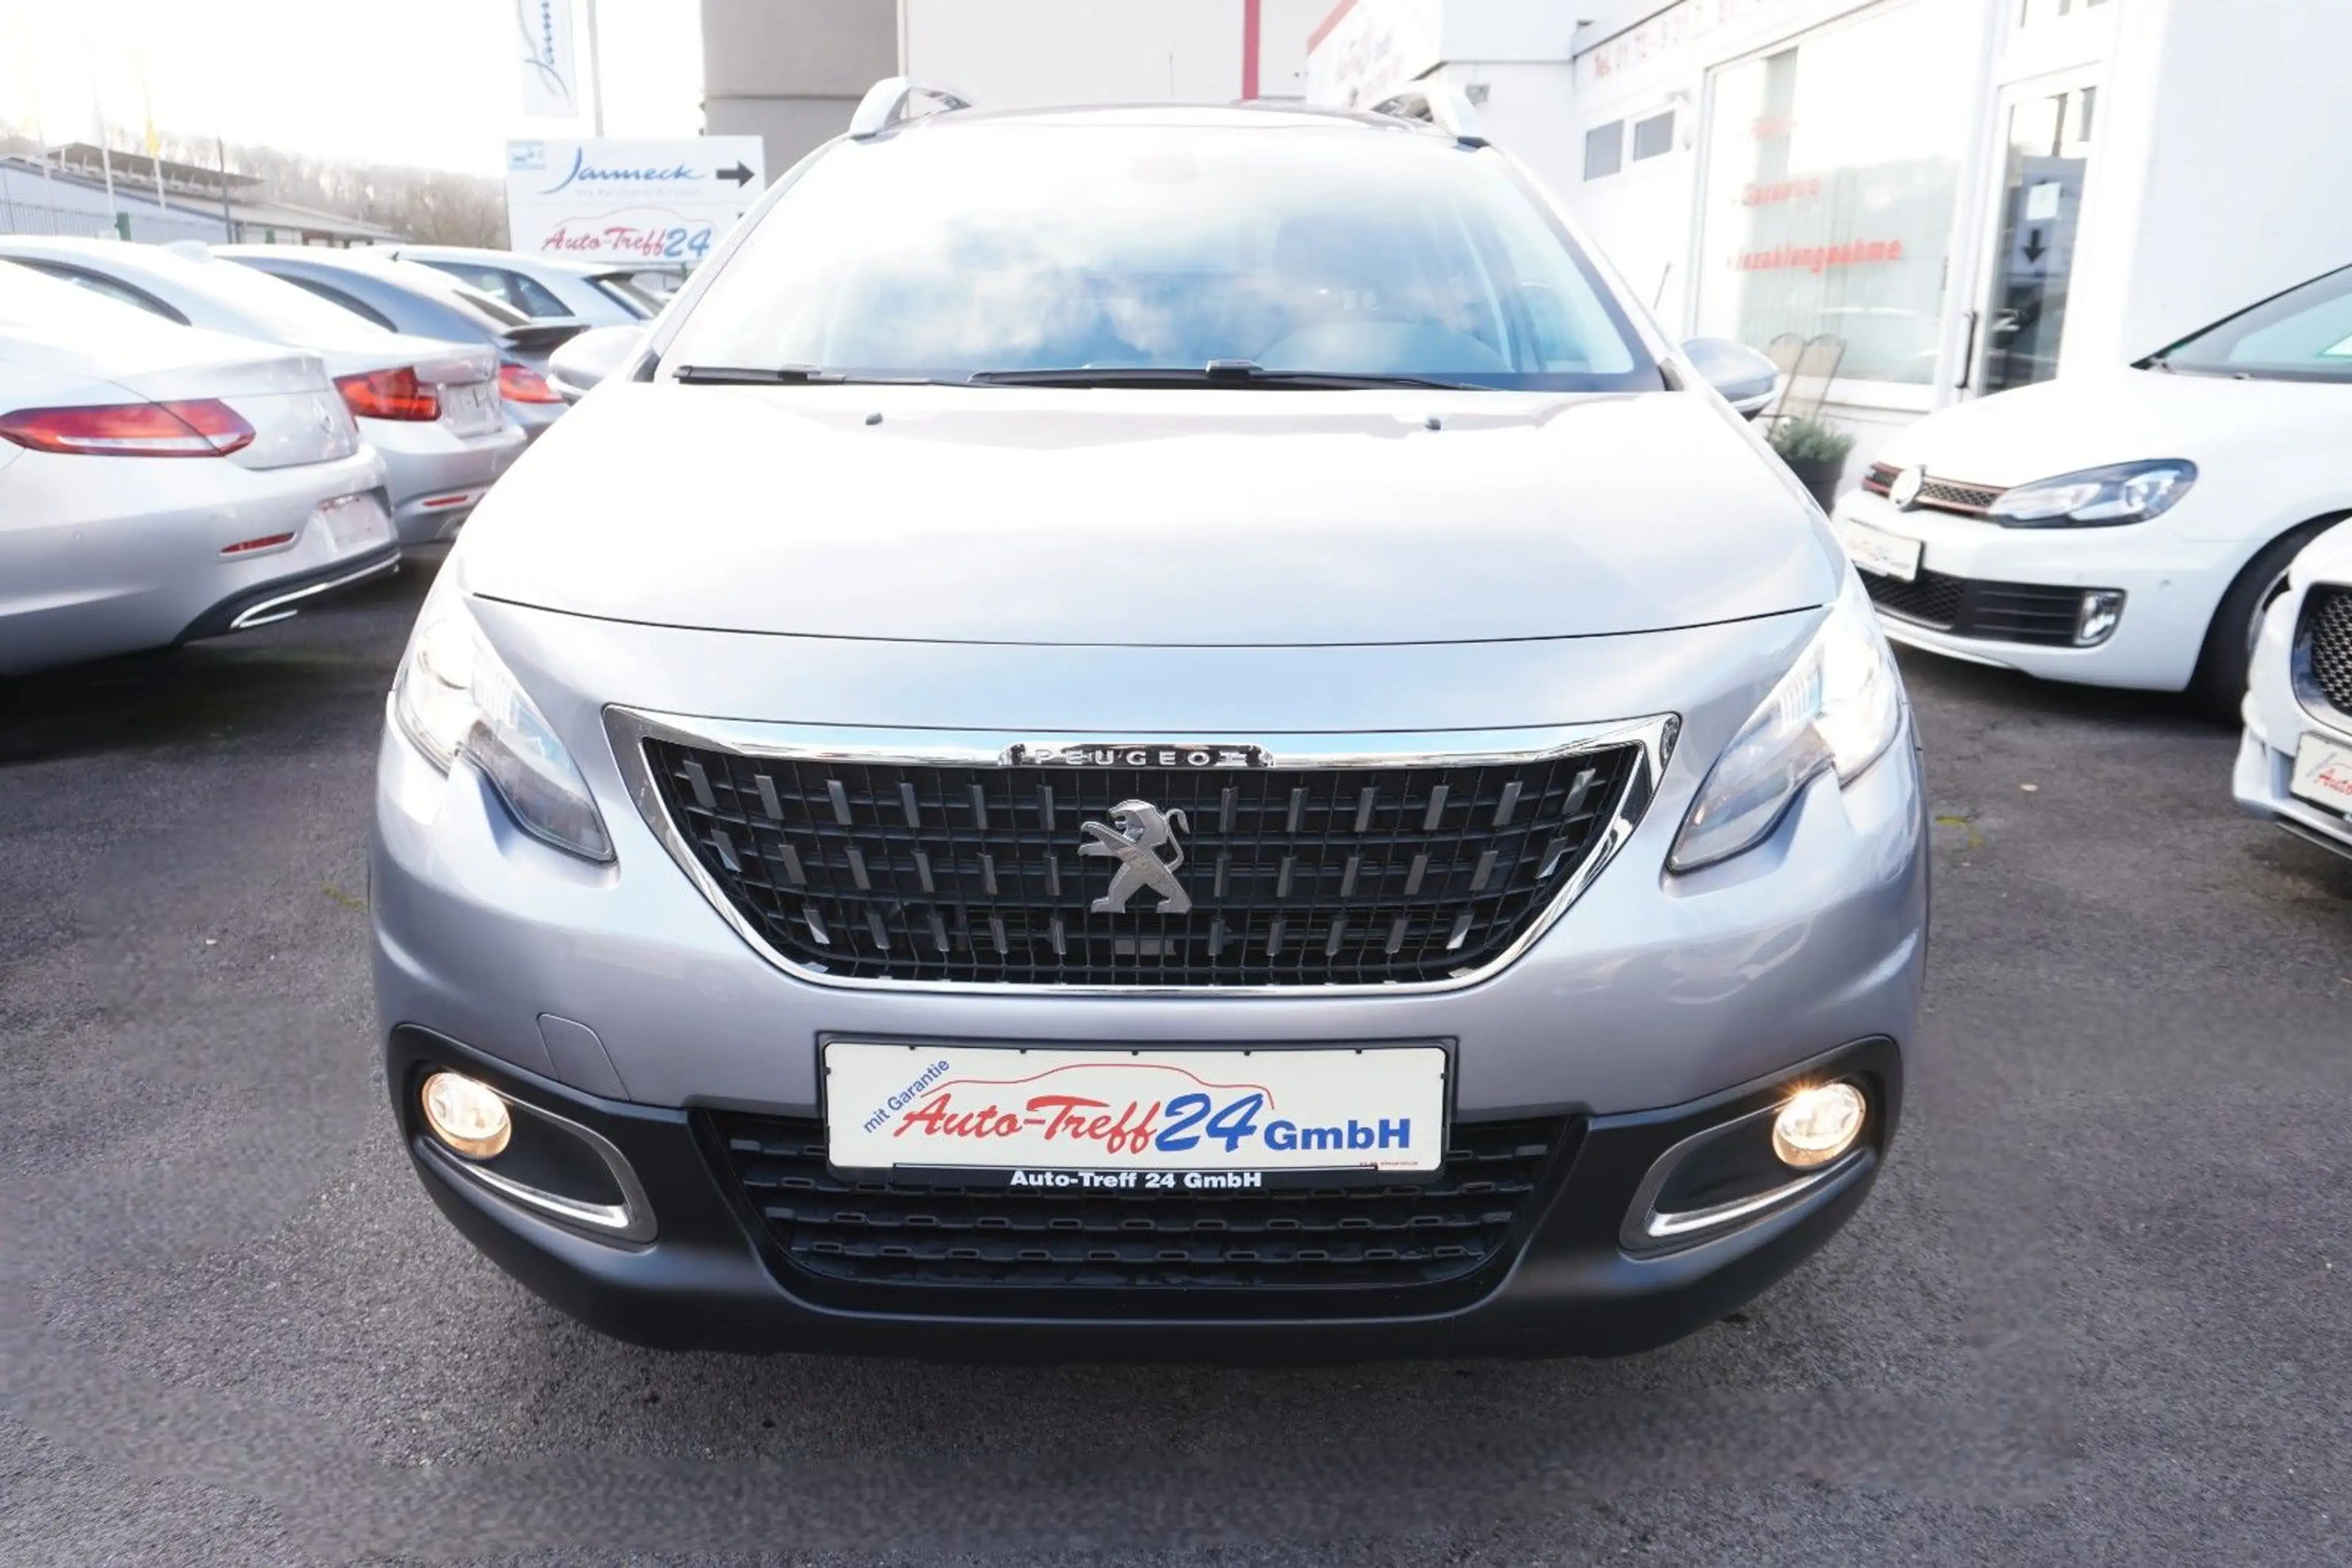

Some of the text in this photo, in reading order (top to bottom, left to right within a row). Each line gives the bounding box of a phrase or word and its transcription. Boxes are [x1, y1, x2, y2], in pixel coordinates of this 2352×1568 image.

[541, 227, 712, 258] Auto-Treff24
[864, 1060, 949, 1133] mit Garantie
[893, 1093, 1411, 1155] Auto-Treff24 GmbH
[1010, 1170, 1262, 1188] Auto-Treff 24 GmbH
